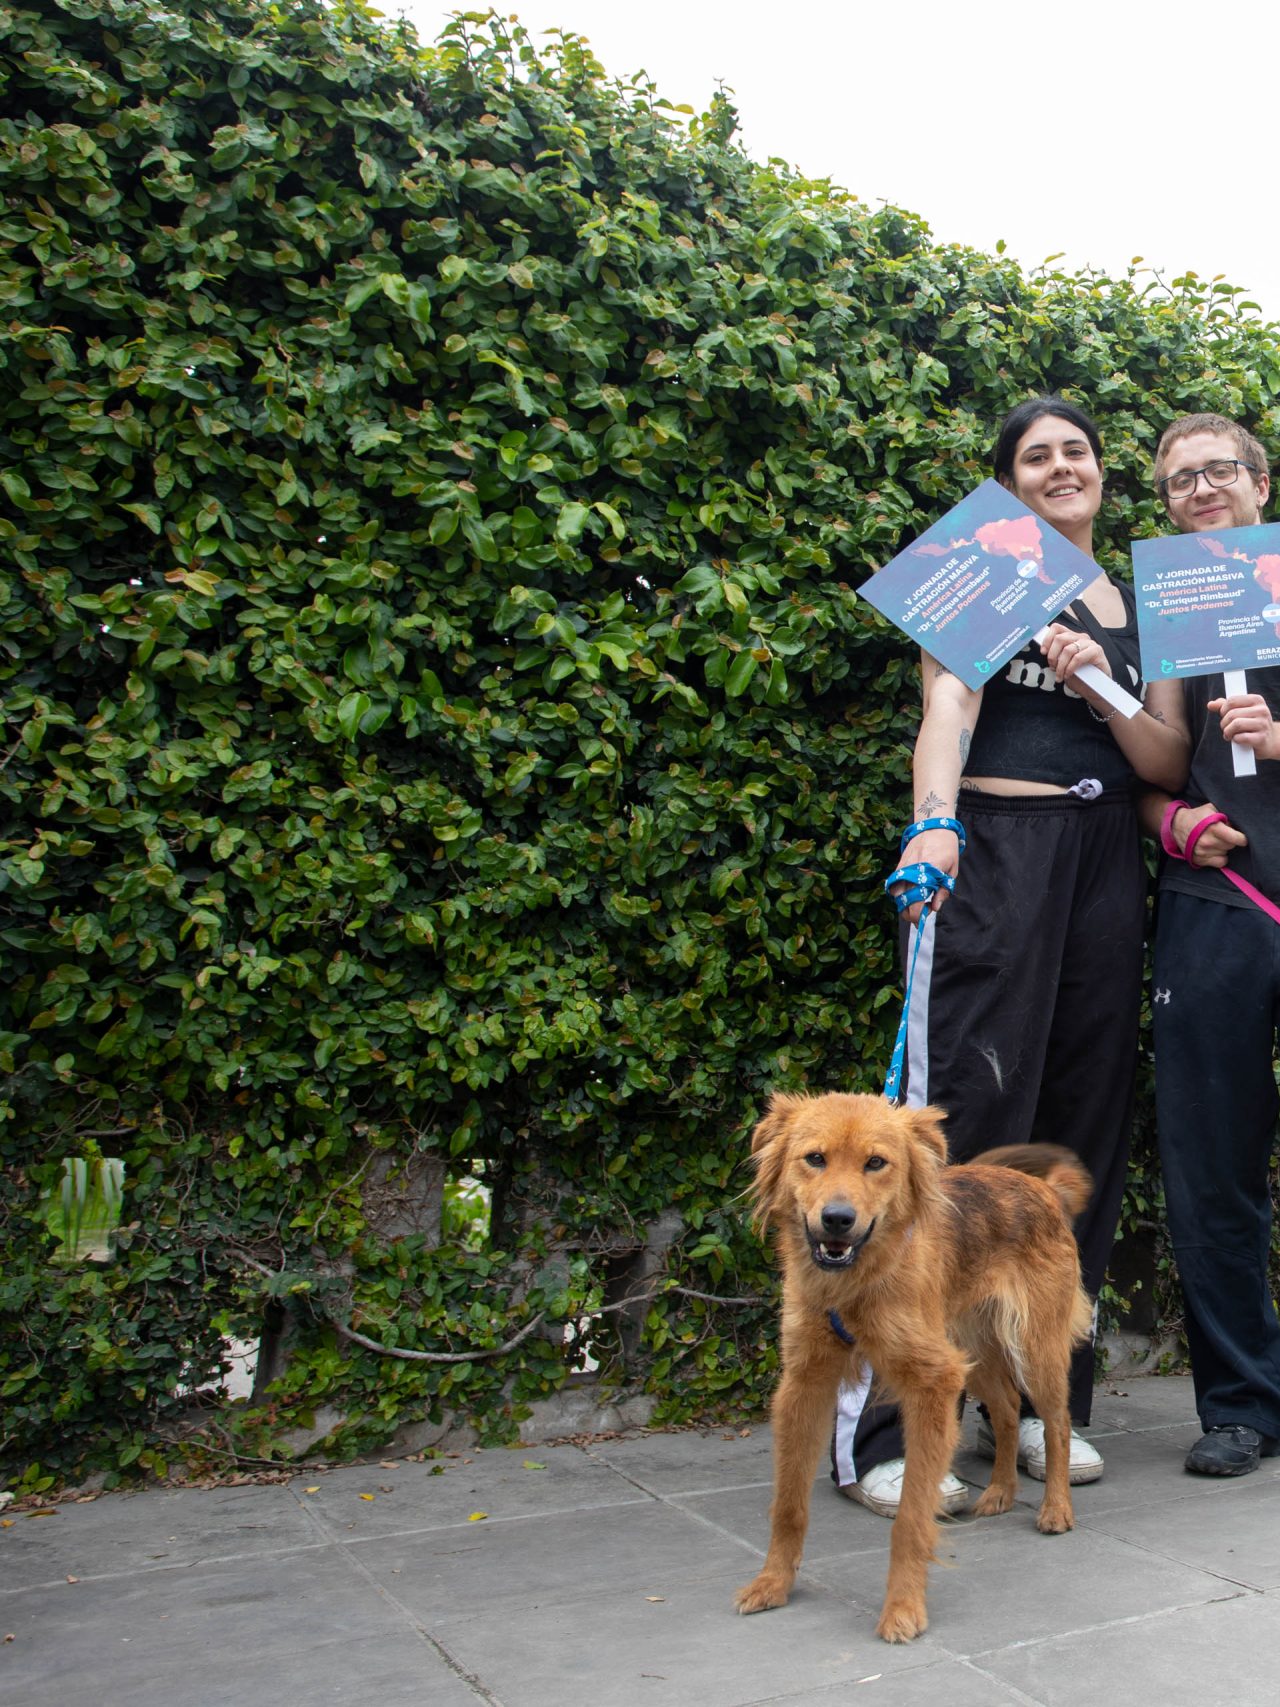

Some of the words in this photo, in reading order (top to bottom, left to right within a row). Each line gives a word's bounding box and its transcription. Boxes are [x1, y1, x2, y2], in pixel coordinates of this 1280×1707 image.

[904, 598, 912, 606] V
[912, 567, 949, 601] JORNADA
[945, 557, 959, 570] DE
[1142, 577, 1206, 591] CASTRACIÓN
[1207, 572, 1245, 583] MASIVA
[1164, 567, 1212, 579] JORNADA
[1213, 564, 1227, 573] DE
[902, 578, 951, 622] CASTRACIÓN
[948, 554, 979, 581] MASIVA
[921, 590, 952, 618] América
[949, 571, 974, 592] Latina
[1041, 574, 1079, 608] BERAZATEGUI
[1159, 587, 1198, 598] América
[1199, 583, 1228, 593] Latina
[930, 597, 959, 622] Enrique
[935, 609, 959, 632] Juntos
[957, 580, 991, 611] Podemos
[1000, 589, 1028, 615] Argentina
[1157, 606, 1190, 616] Juntos
[1191, 599, 1234, 612] Podemos
[1163, 596, 1199, 606] Enrique
[1218, 616, 1251, 626] Provincia
[1219, 628, 1256, 637] Argentina
